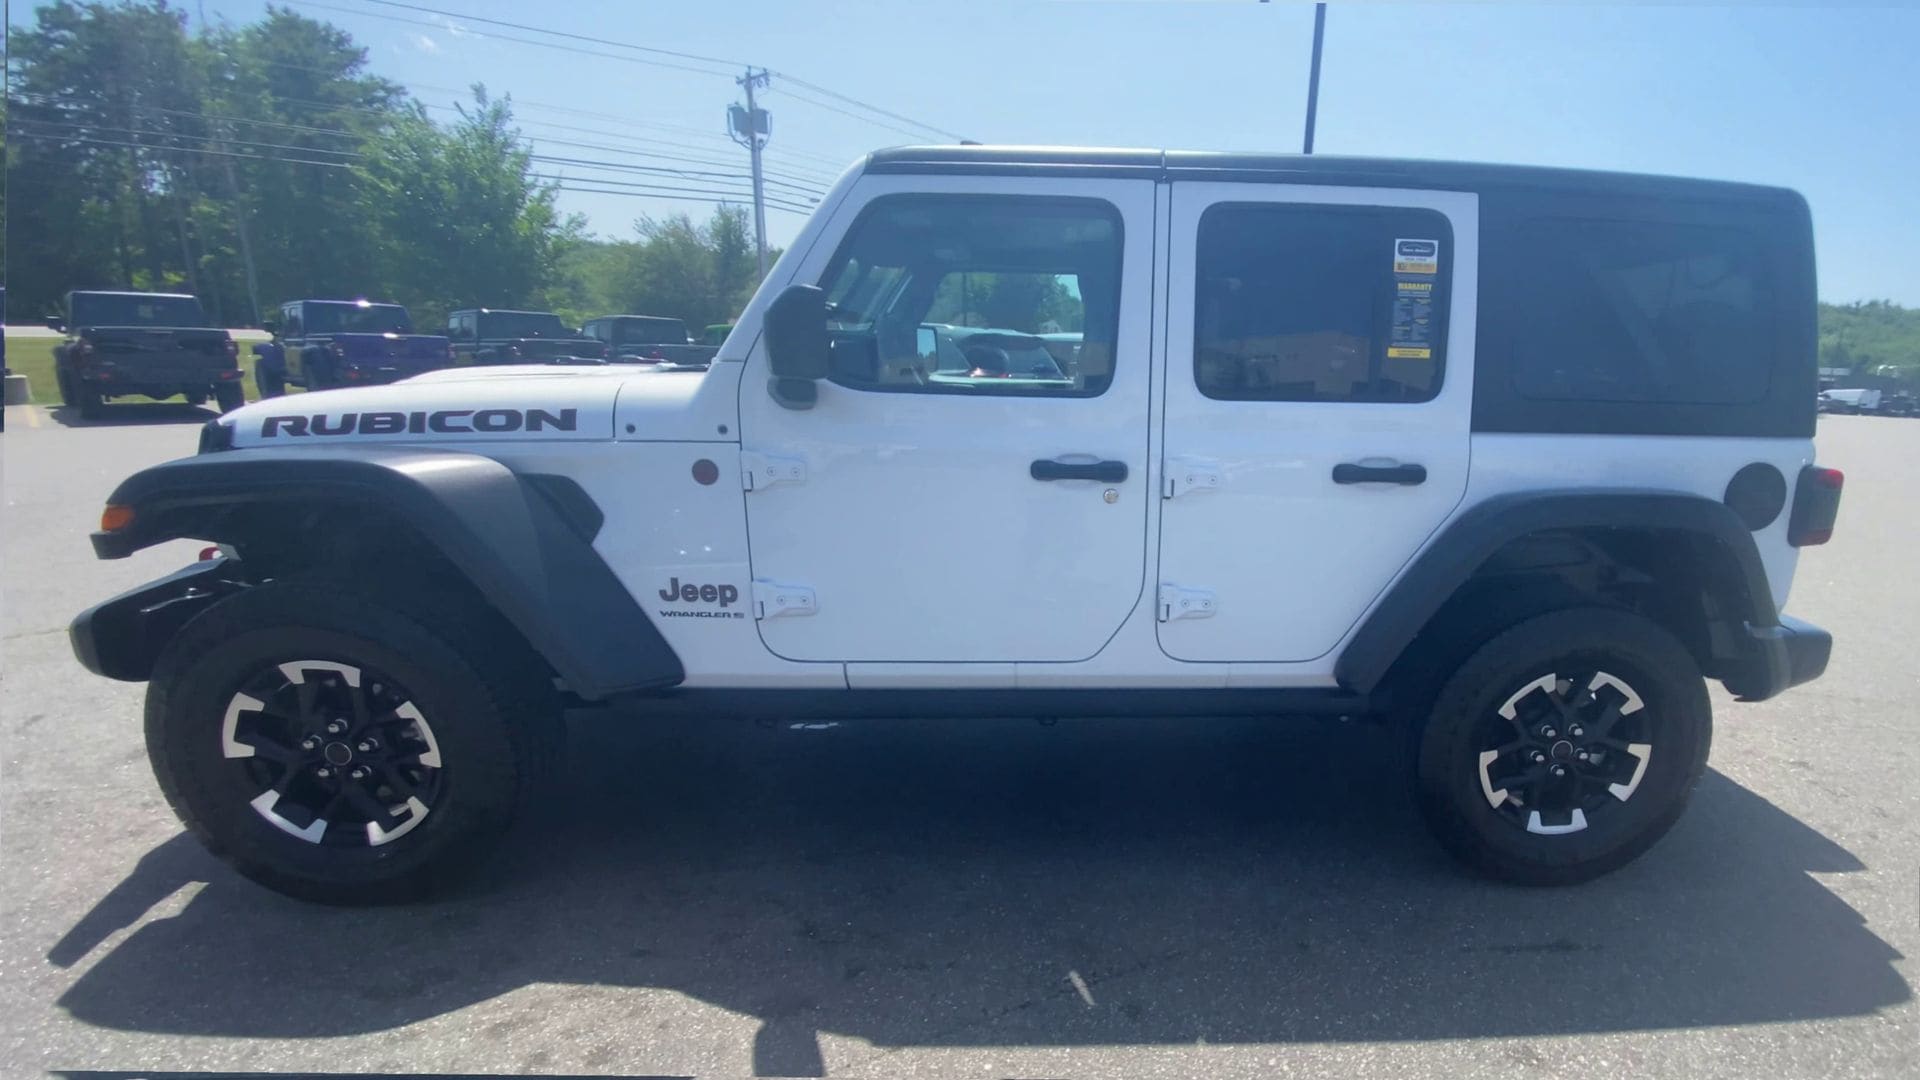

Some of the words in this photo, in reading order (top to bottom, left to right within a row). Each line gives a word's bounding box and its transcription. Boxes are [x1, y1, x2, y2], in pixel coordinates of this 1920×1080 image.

[261, 408, 577, 437] RUBICON
[659, 577, 738, 607] Jeep
[659, 610, 732, 618] WRANGLER
